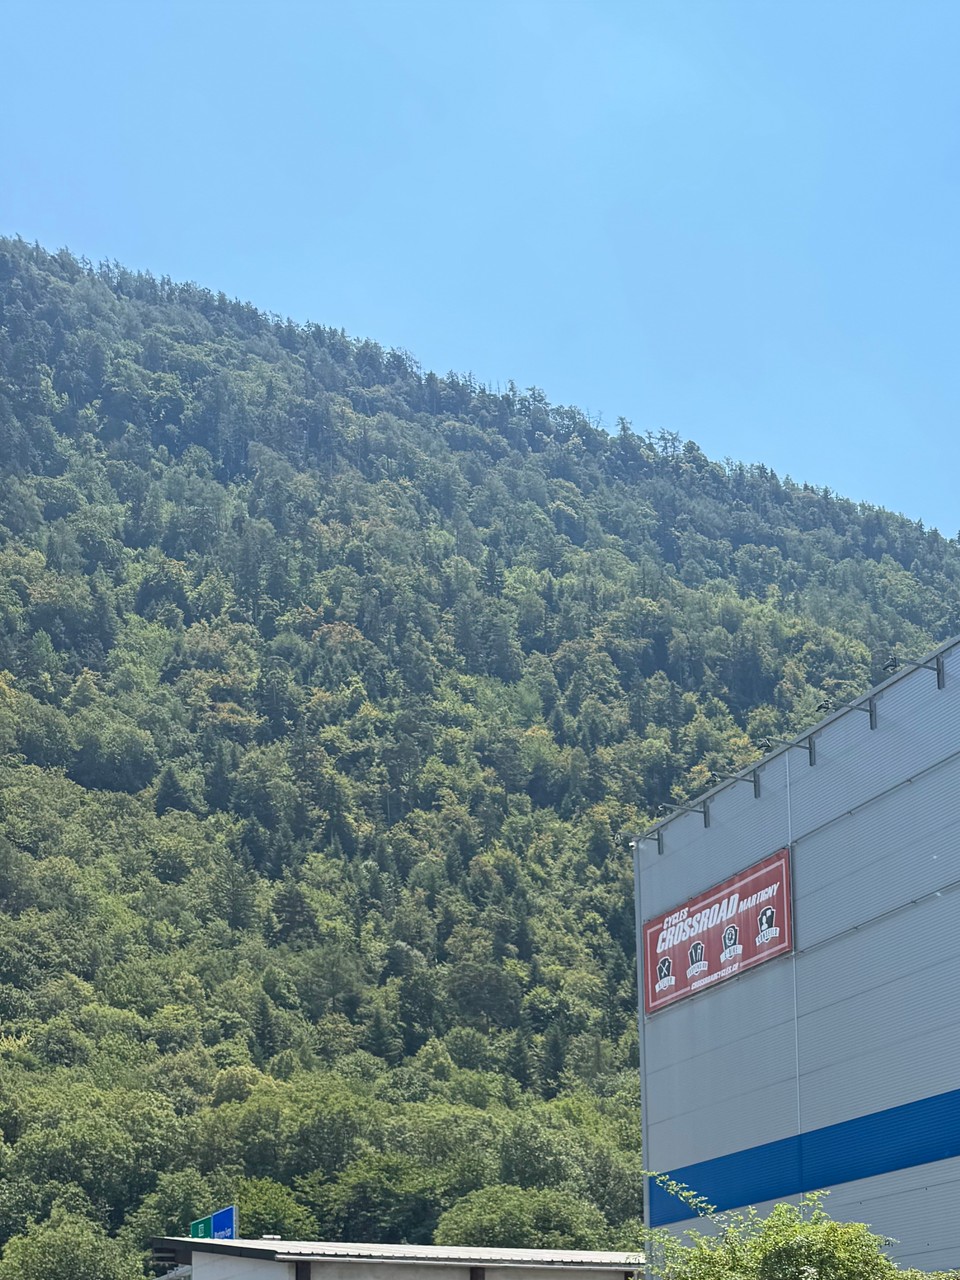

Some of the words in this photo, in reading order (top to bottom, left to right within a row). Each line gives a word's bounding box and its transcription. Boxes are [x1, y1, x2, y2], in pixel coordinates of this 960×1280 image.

[656, 893, 739, 953] CROSSROAD
[738, 882, 780, 913] MARTIGNY
[663, 907, 689, 929] CYCLES
